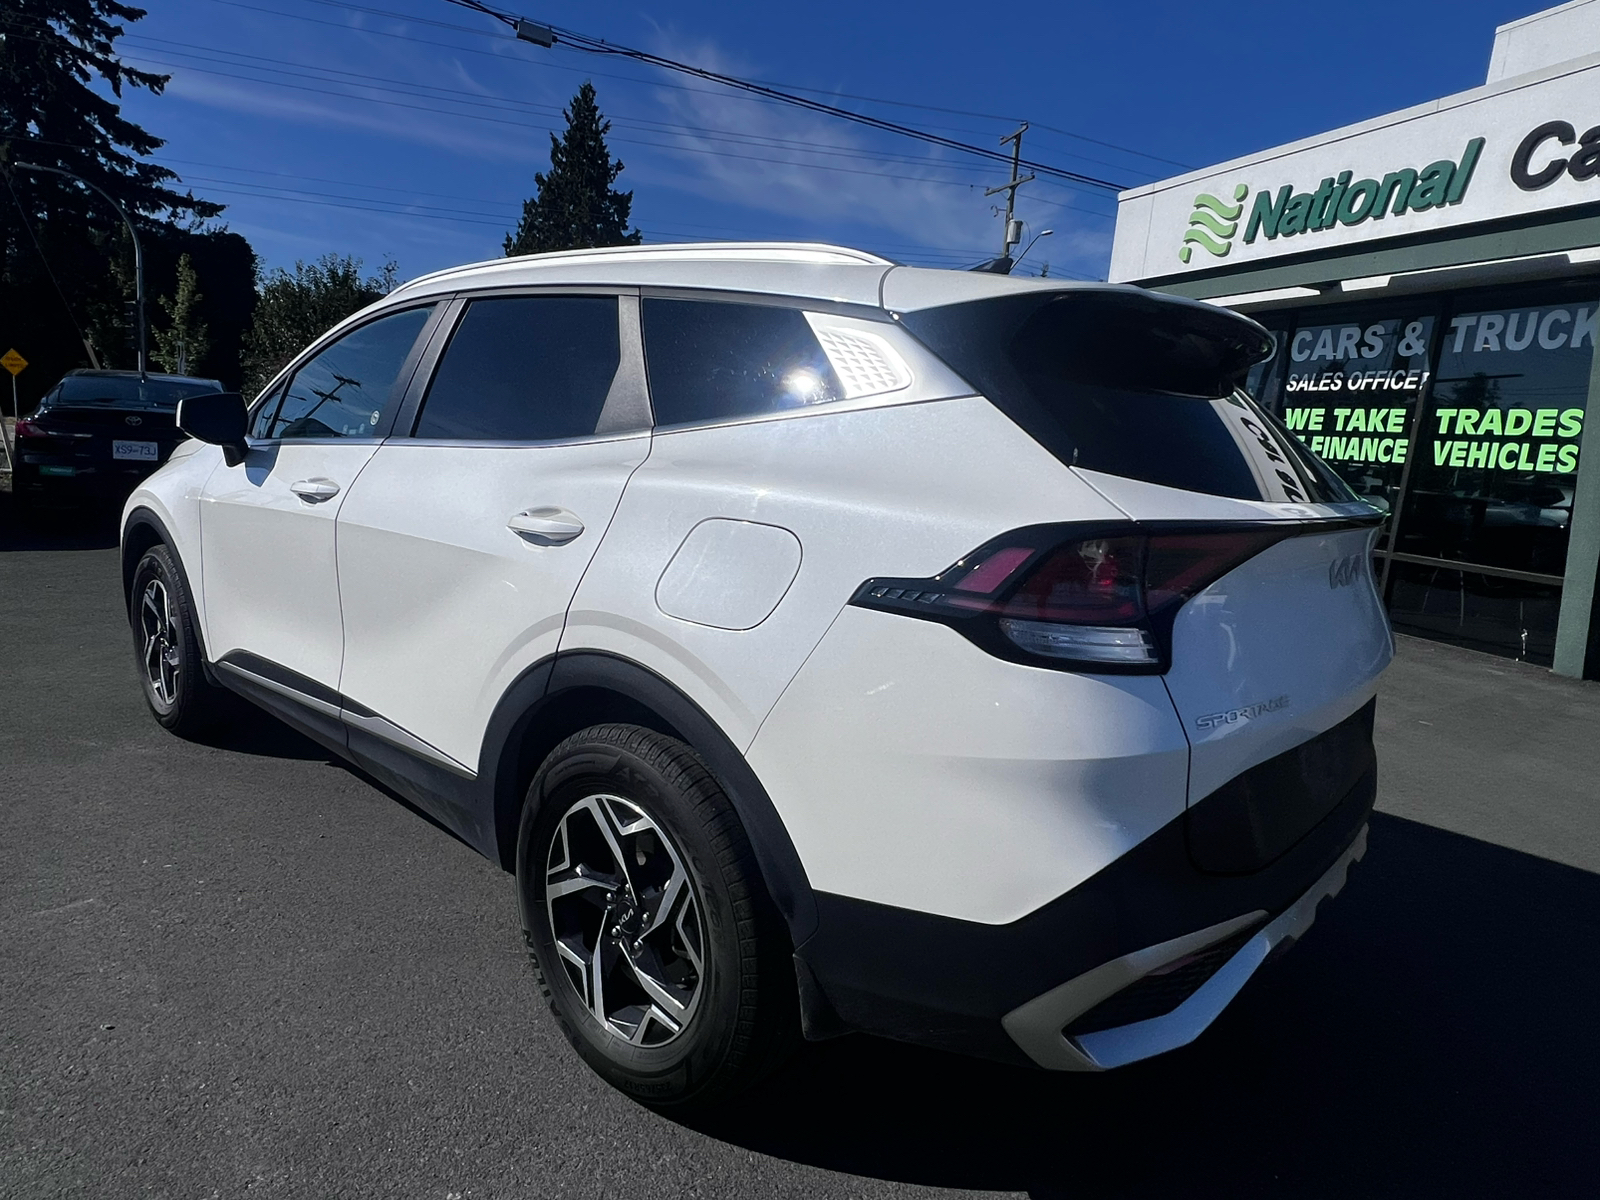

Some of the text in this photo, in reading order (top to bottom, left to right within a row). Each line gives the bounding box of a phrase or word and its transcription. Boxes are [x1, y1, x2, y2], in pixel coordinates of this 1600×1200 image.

[1242, 137, 1486, 245] National
[1291, 324, 1386, 362] CARS
[1397, 321, 1426, 357] &
[1286, 371, 1344, 392] SALES
[1285, 408, 1585, 438] WE TAKE TRADES
[1310, 435, 1580, 473] FINANCE VEHICLES
